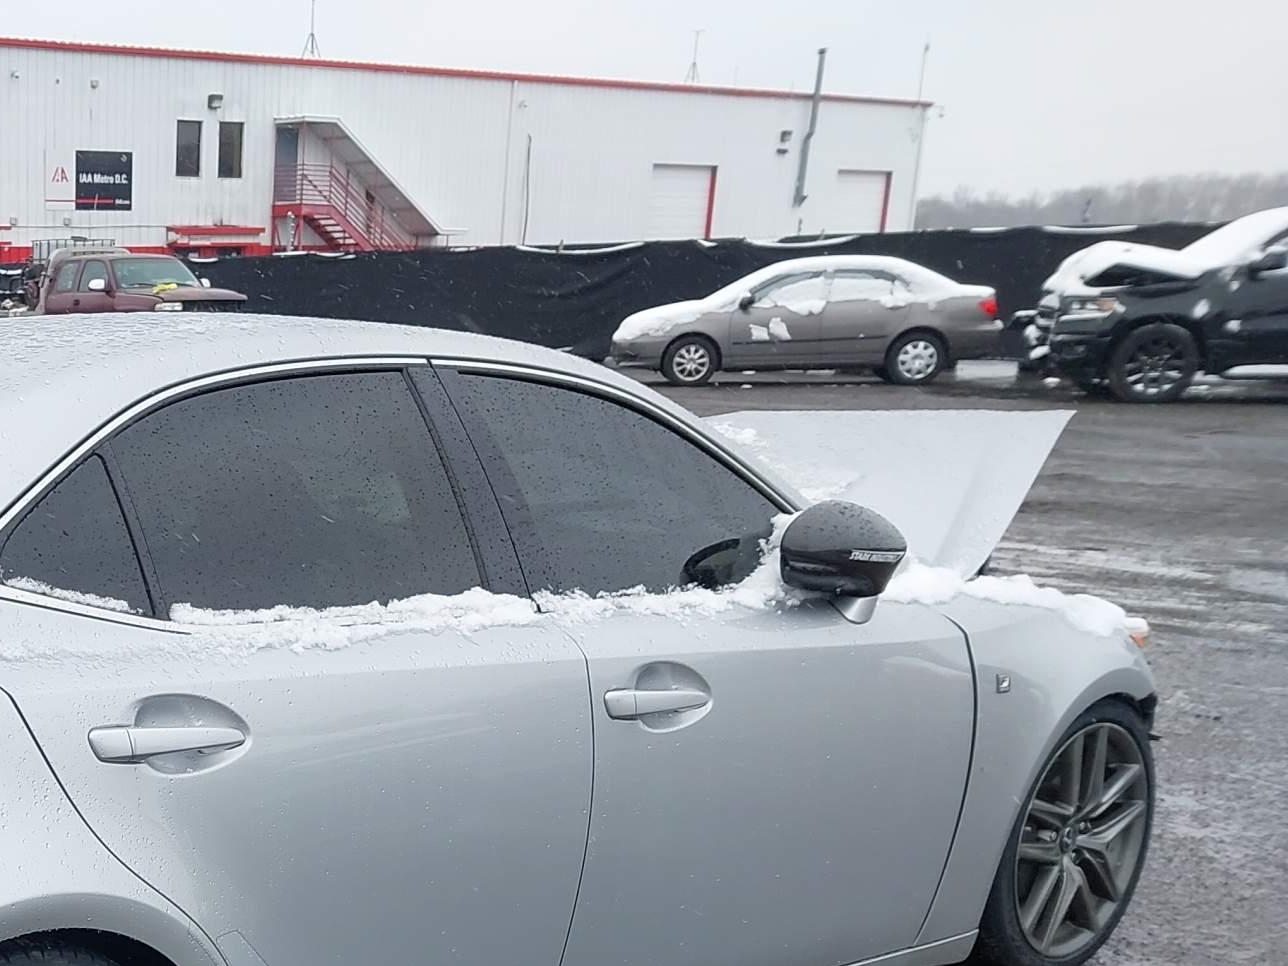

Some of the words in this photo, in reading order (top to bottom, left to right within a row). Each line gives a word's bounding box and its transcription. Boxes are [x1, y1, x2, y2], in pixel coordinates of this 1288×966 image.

[79, 173, 92, 183] IAA
[93, 173, 114, 184] Metro
[115, 174, 128, 184] D.C.
